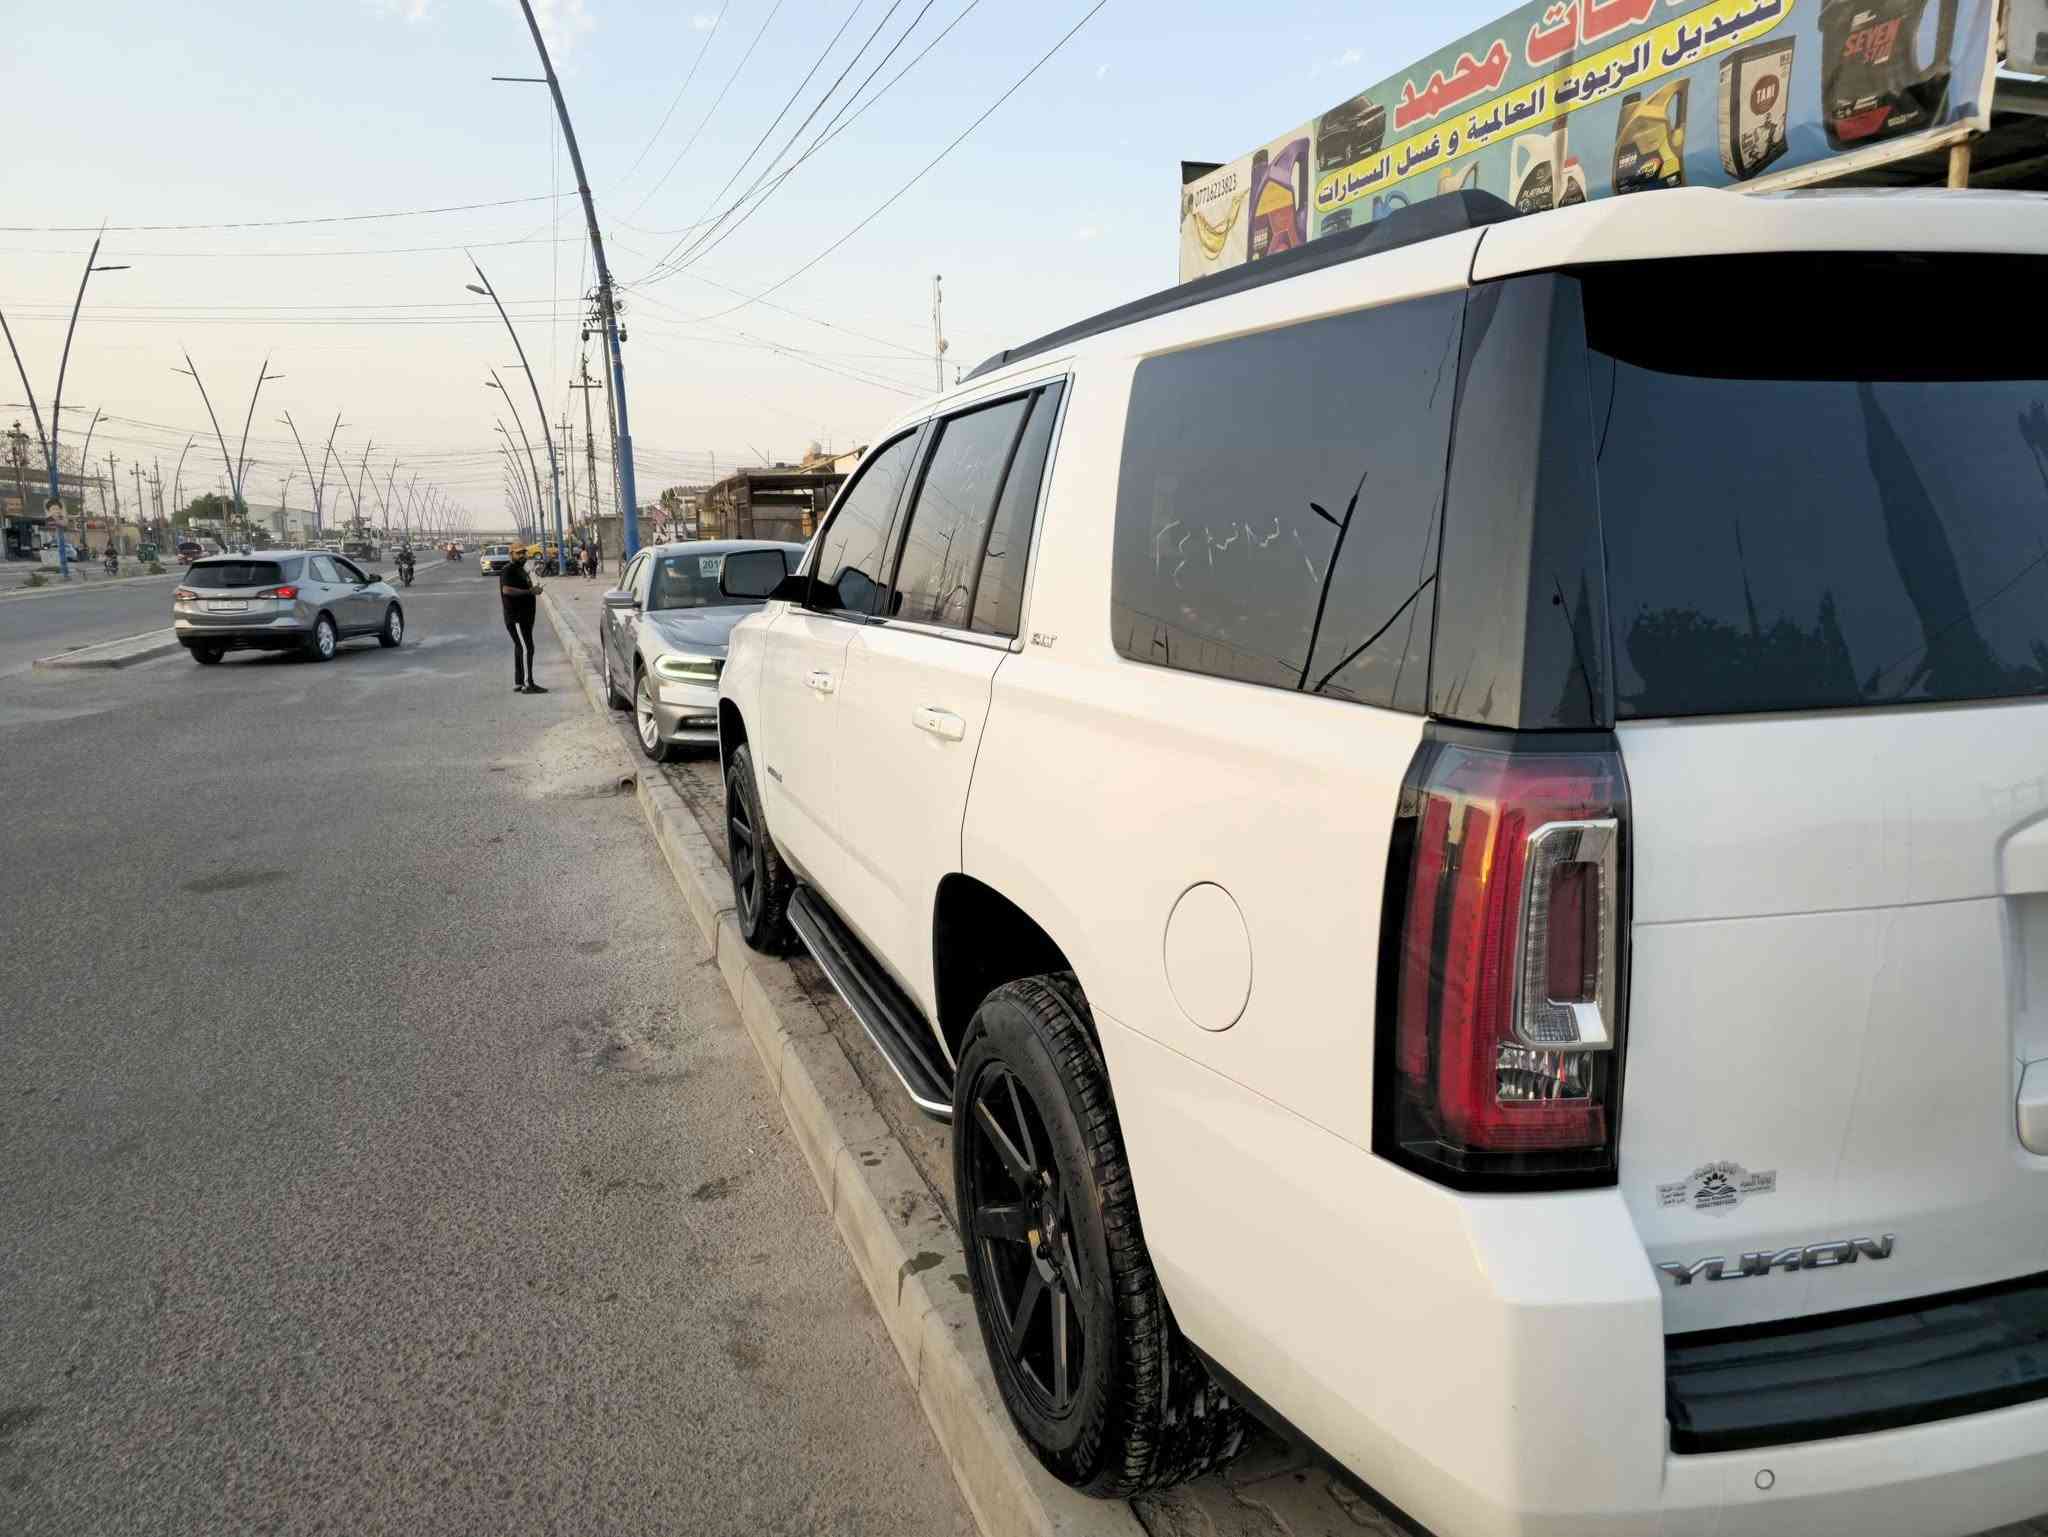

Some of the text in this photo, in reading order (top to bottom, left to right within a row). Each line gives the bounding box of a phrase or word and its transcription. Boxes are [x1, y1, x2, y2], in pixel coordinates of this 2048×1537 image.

[1393, 39, 1512, 131] محمد
[1555, 41, 1651, 101] الزيوت
[1467, 85, 1546, 143] العالمية
[1397, 133, 1441, 176] غسل
[1447, 130, 1459, 156] و
[1318, 154, 1391, 203] السيارات
[702, 559, 720, 570] 201
[1657, 1233, 1896, 1286] YUKON
